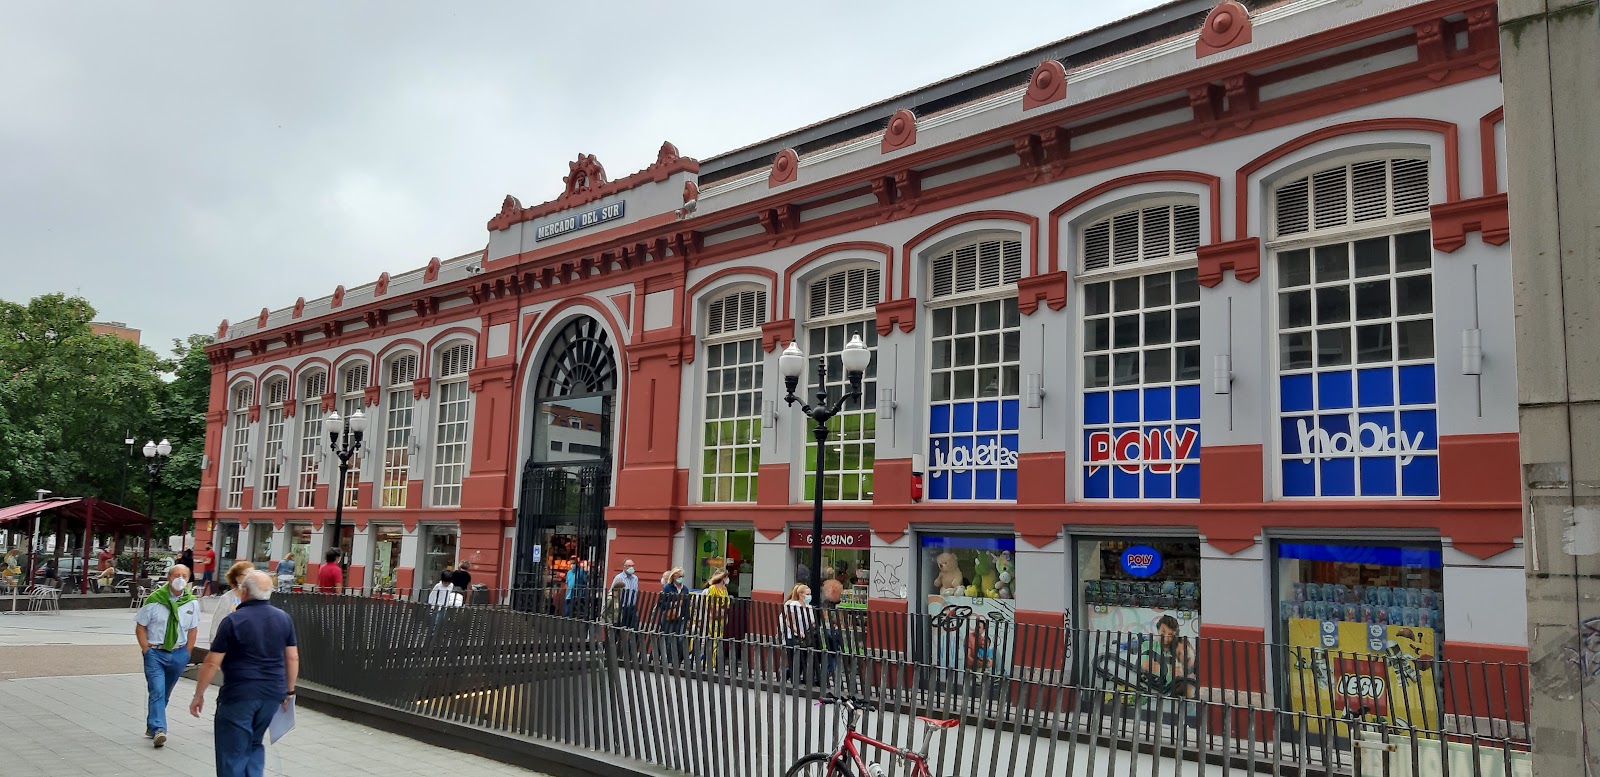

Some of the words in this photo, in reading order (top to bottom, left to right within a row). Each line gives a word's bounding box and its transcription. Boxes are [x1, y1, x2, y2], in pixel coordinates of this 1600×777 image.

[537, 217, 575, 239] MERCADO
[581, 210, 598, 226] DEL
[601, 203, 620, 220] SUR
[932, 438, 1018, 478] juguetes
[1088, 427, 1198, 477] POLY
[1296, 413, 1424, 466] hobby
[1127, 554, 1153, 566] POLY
[1337, 673, 1385, 699] LEGO
